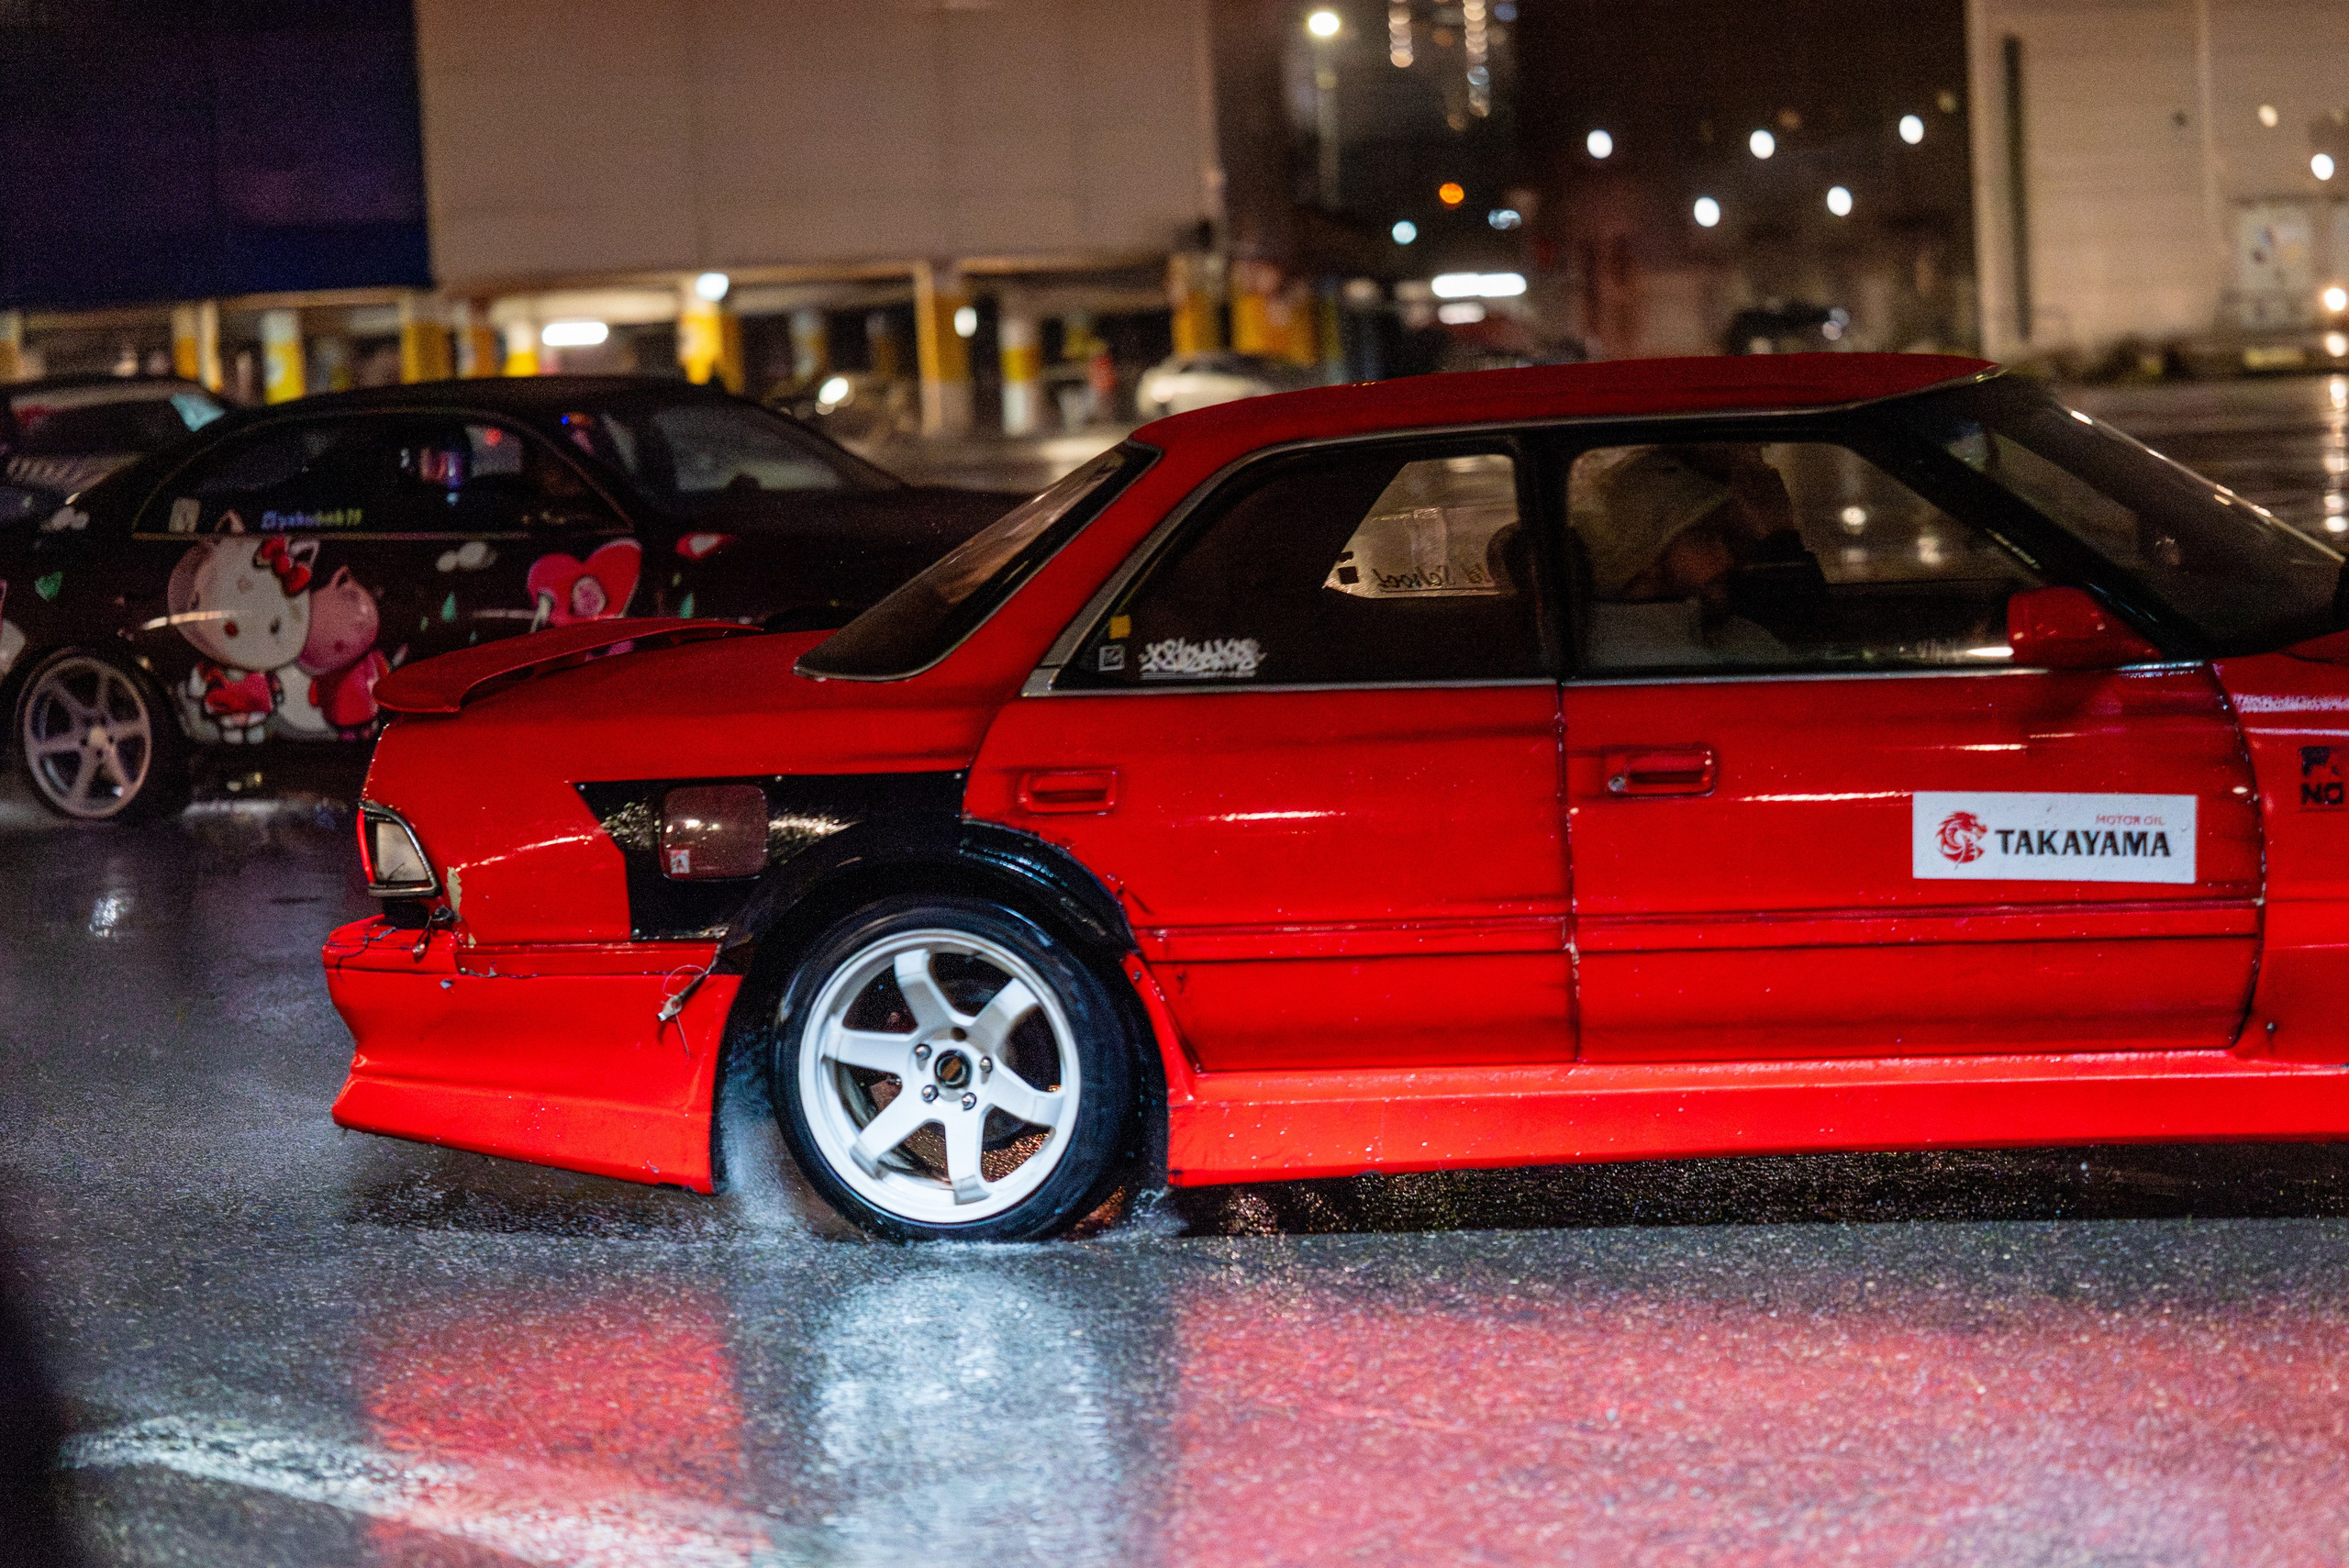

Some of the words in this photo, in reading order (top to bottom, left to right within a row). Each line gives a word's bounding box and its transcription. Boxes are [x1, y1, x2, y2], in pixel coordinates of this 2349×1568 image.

[2096, 814, 2140, 825] MOTOR
[2143, 815, 2165, 826] OIL
[1995, 828, 2171, 857] TAKAYAMA
